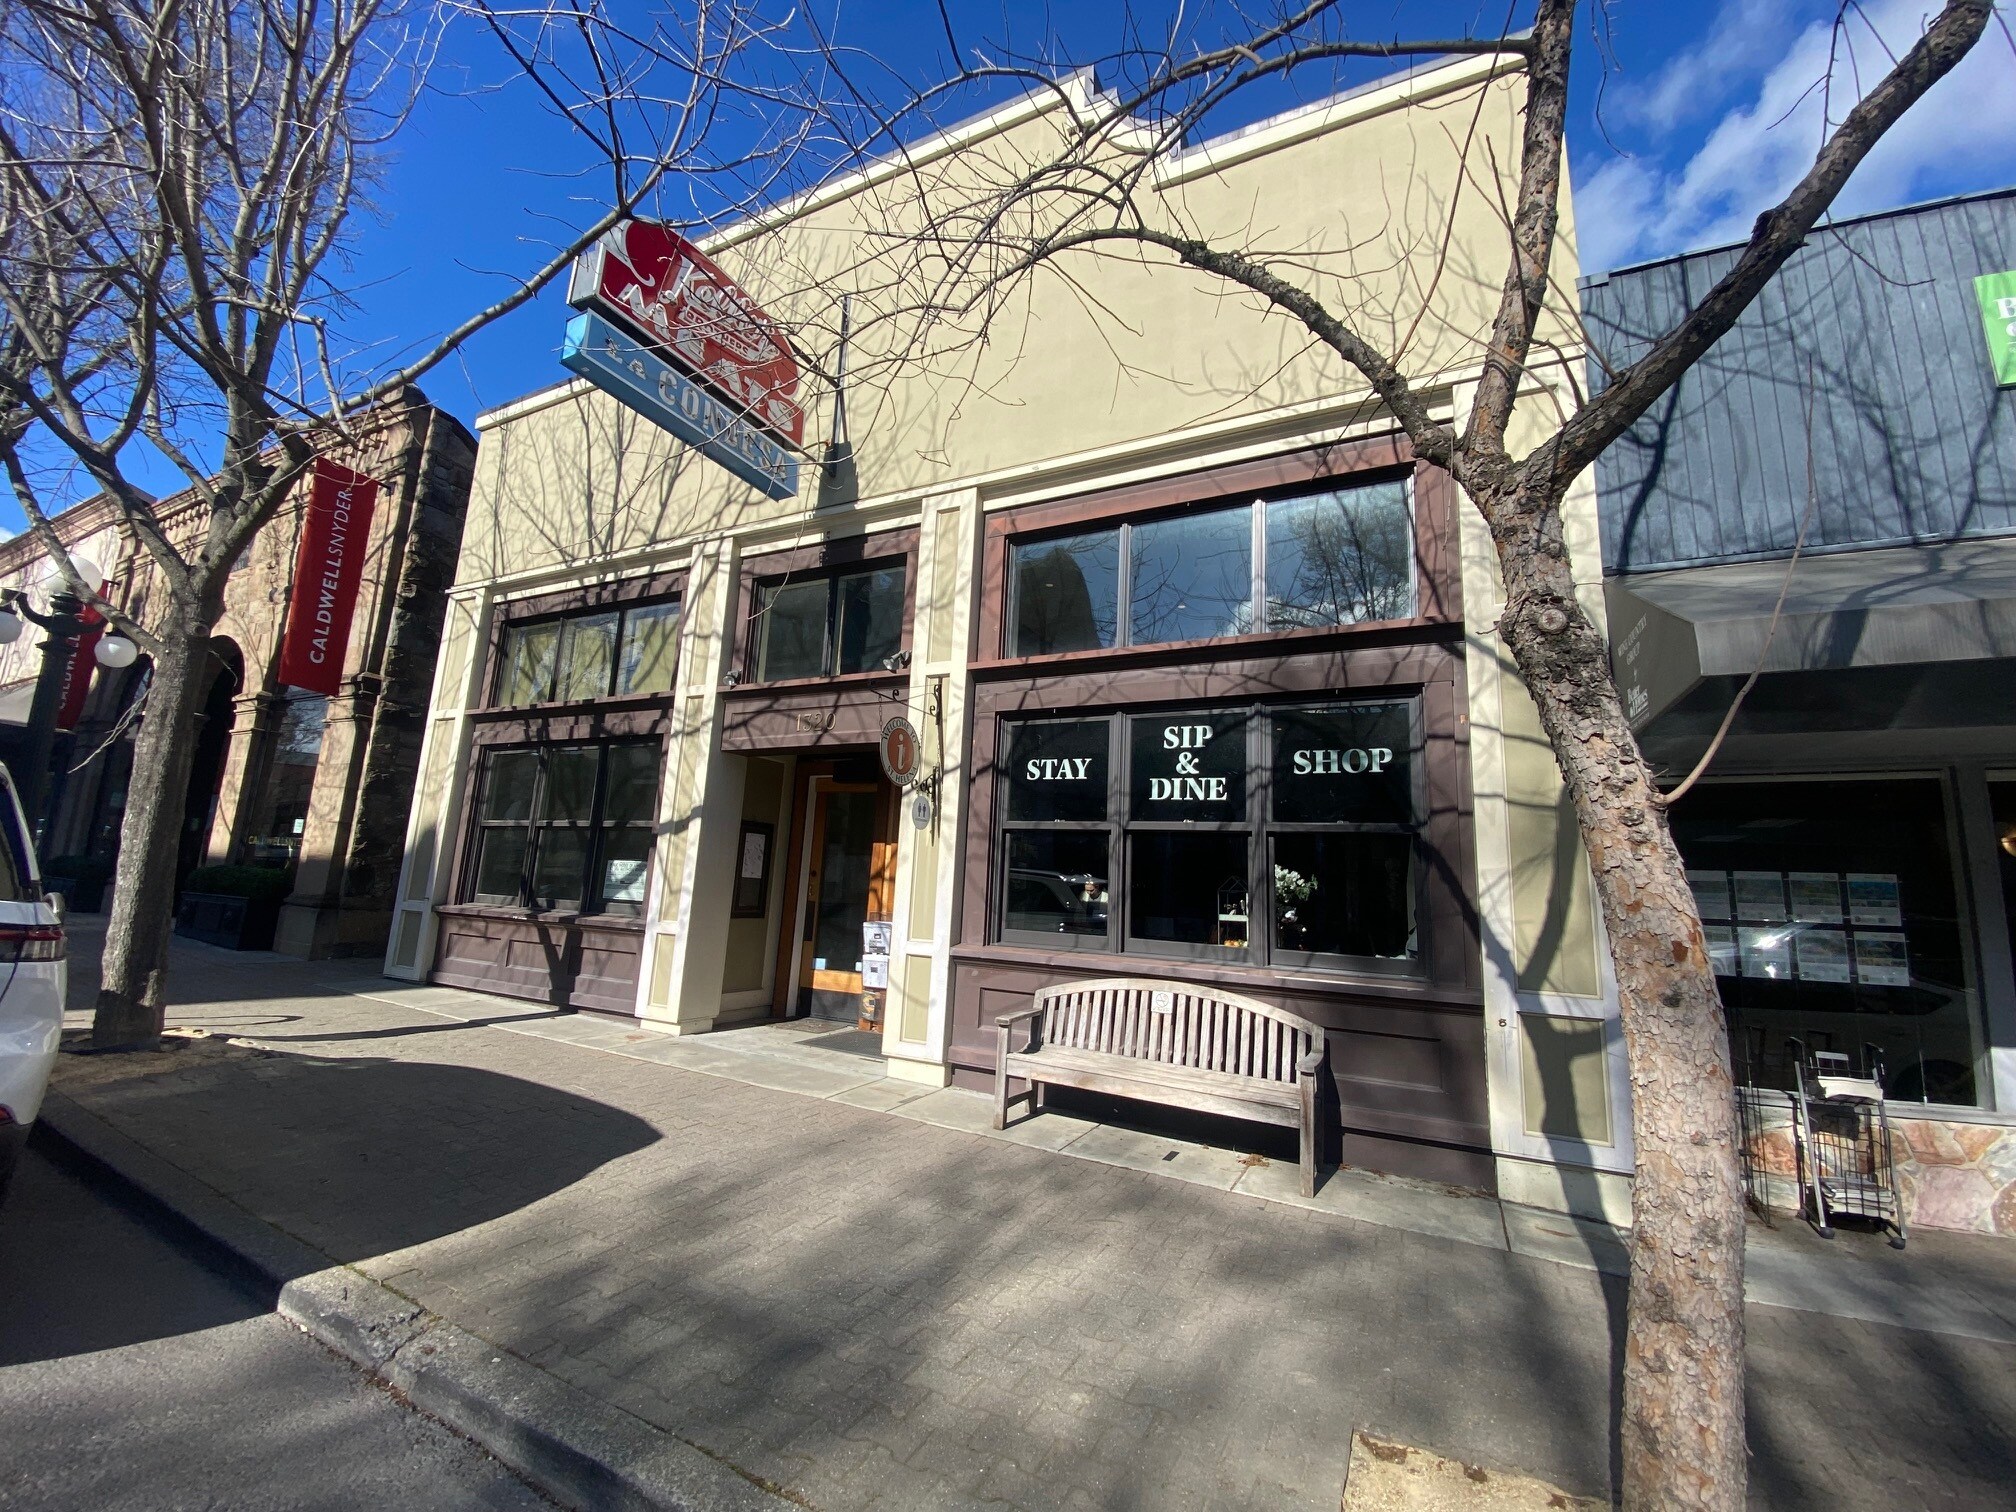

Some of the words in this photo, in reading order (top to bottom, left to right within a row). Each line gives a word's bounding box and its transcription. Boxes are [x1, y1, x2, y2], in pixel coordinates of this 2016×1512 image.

[617, 283, 795, 432] MEATS
[309, 490, 353, 664] CALDWELLSNYDER
[795, 712, 837, 732] 1320
[883, 719, 908, 740] WELCOME
[1163, 725, 1214, 749] SIP
[1026, 758, 1092, 781] STAY
[1175, 751, 1200, 775] &
[1293, 748, 1393, 775] SHOP
[1149, 777, 1228, 801] DINE
